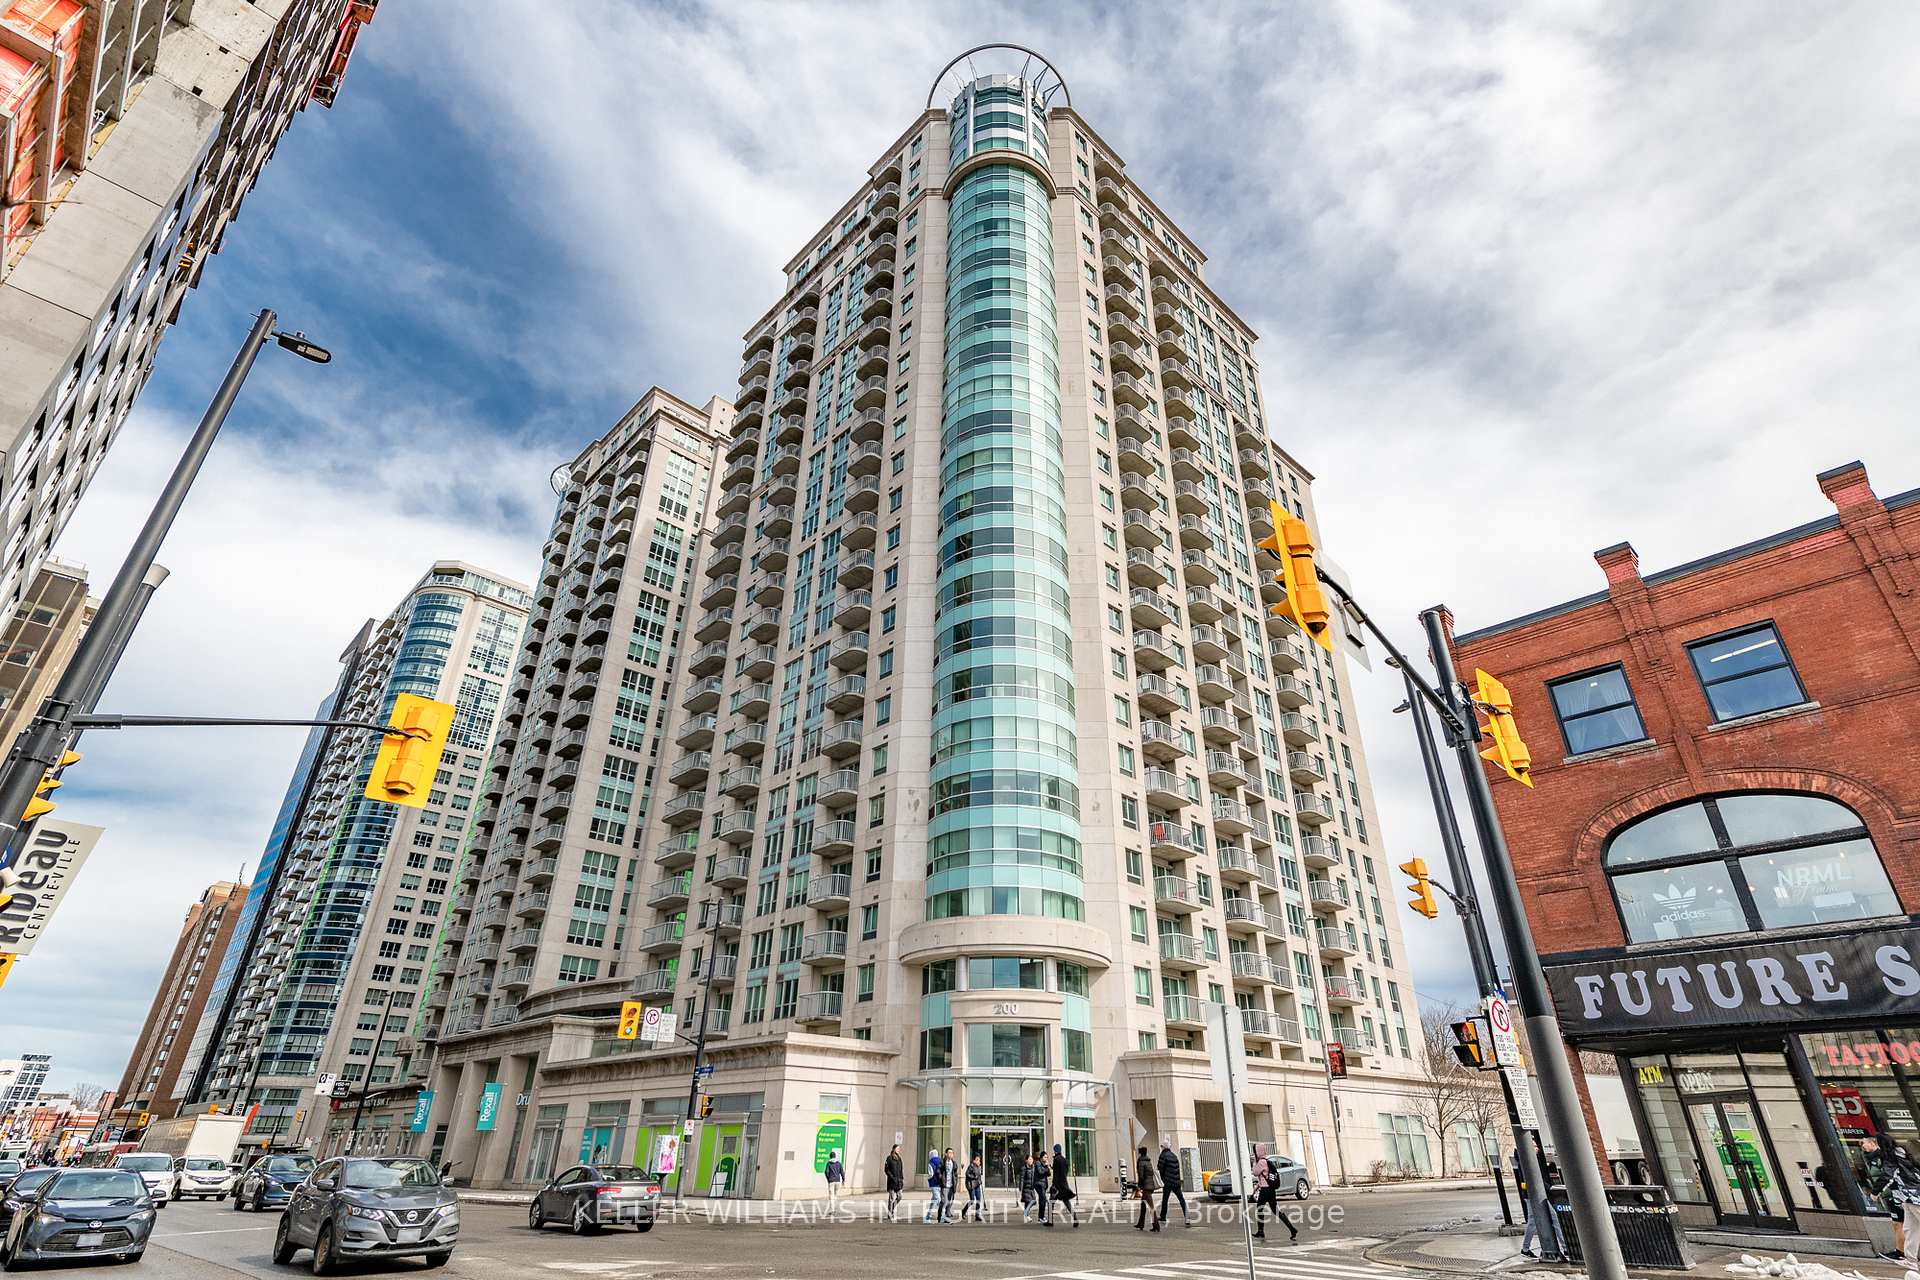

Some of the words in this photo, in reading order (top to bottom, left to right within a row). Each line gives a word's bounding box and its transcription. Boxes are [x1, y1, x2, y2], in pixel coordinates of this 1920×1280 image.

[1777, 862, 1855, 887] NRML
[23, 839, 81, 939] CENTRE-VILLE
[1660, 909, 1706, 922] adidas
[1575, 951, 1848, 1019] FUTURE
[1875, 945, 1920, 997] S
[993, 1002, 1019, 1015] 200
[1638, 1066, 1665, 1085] ATM
[1679, 1071, 1715, 1092] OPEN
[414, 1098, 428, 1125] Rexall
[480, 1092, 495, 1122] Rexall
